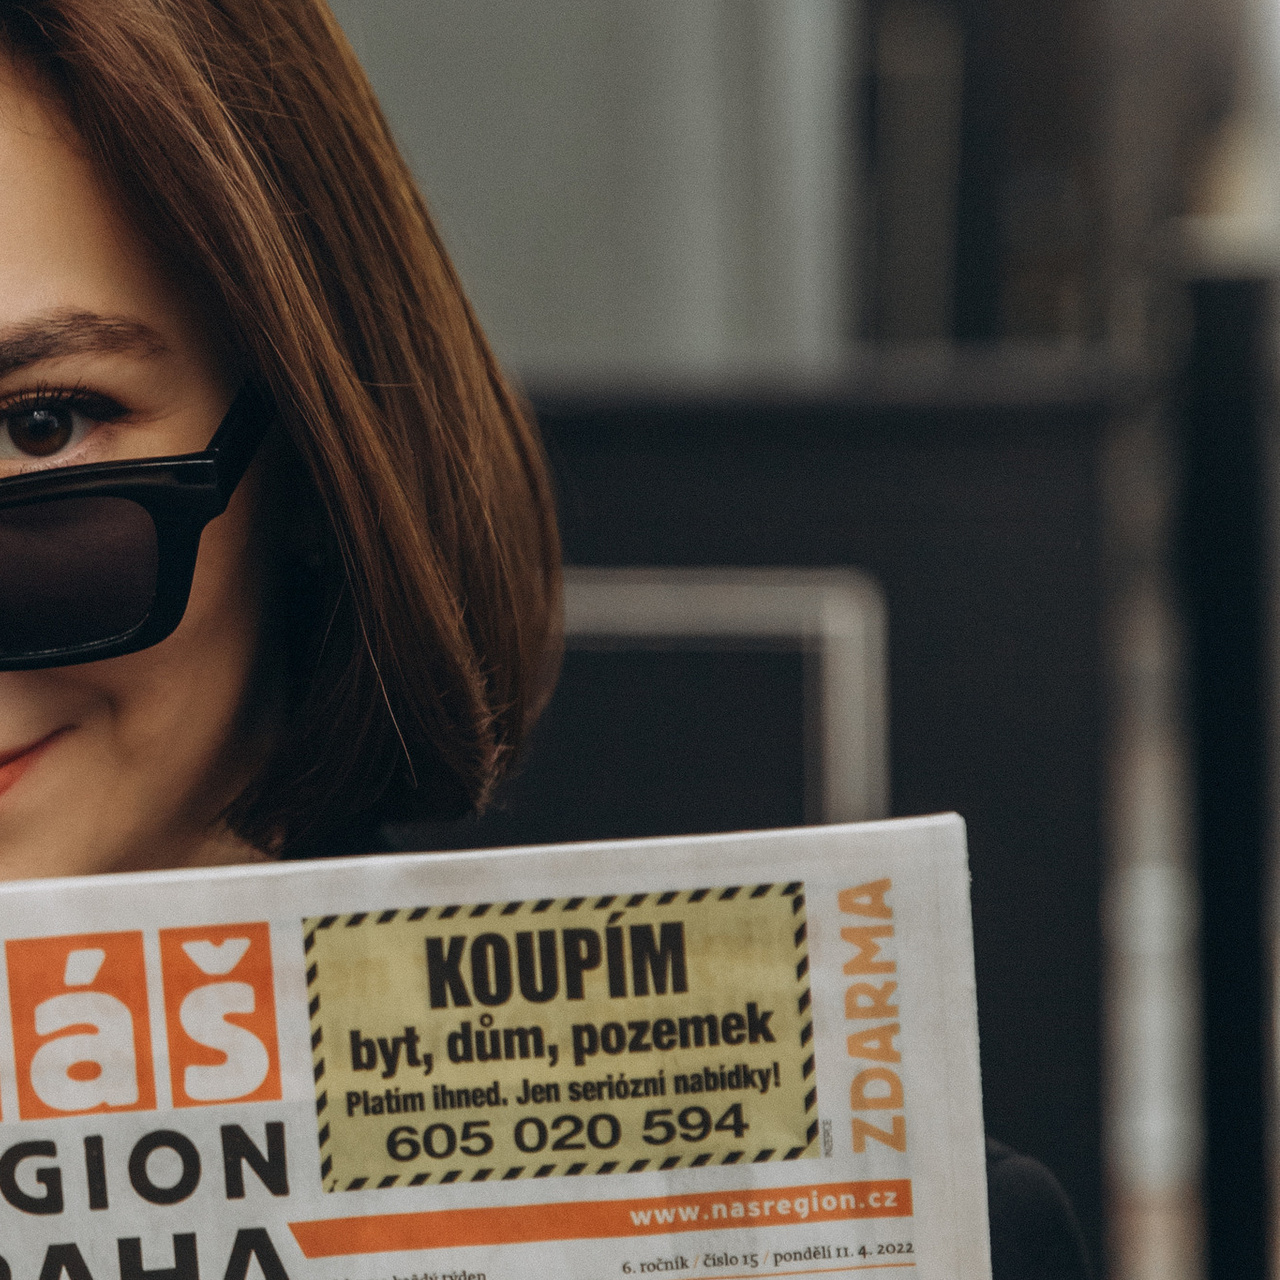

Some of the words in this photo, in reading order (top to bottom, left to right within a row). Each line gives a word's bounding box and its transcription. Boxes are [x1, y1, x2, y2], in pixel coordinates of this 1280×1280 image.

[425, 912, 688, 1009] KOUPÍM
[350, 1026, 433, 1079] byt,
[447, 1013, 558, 1067] dům,
[572, 1003, 775, 1066] pozemek
[837, 877, 907, 1154] ZDARMA
[346, 1088, 425, 1117] Platím
[433, 1081, 508, 1110] ihned.
[516, 1079, 560, 1105] Jen
[568, 1069, 666, 1102] seriózní
[674, 1061, 780, 1094] nabídky!
[386, 1120, 494, 1162] 605
[514, 1113, 621, 1153] 020
[643, 1103, 749, 1145] 594
[630, 1191, 897, 1225] www.nasregion.cz
[773, 1247, 832, 1267] pondělí
